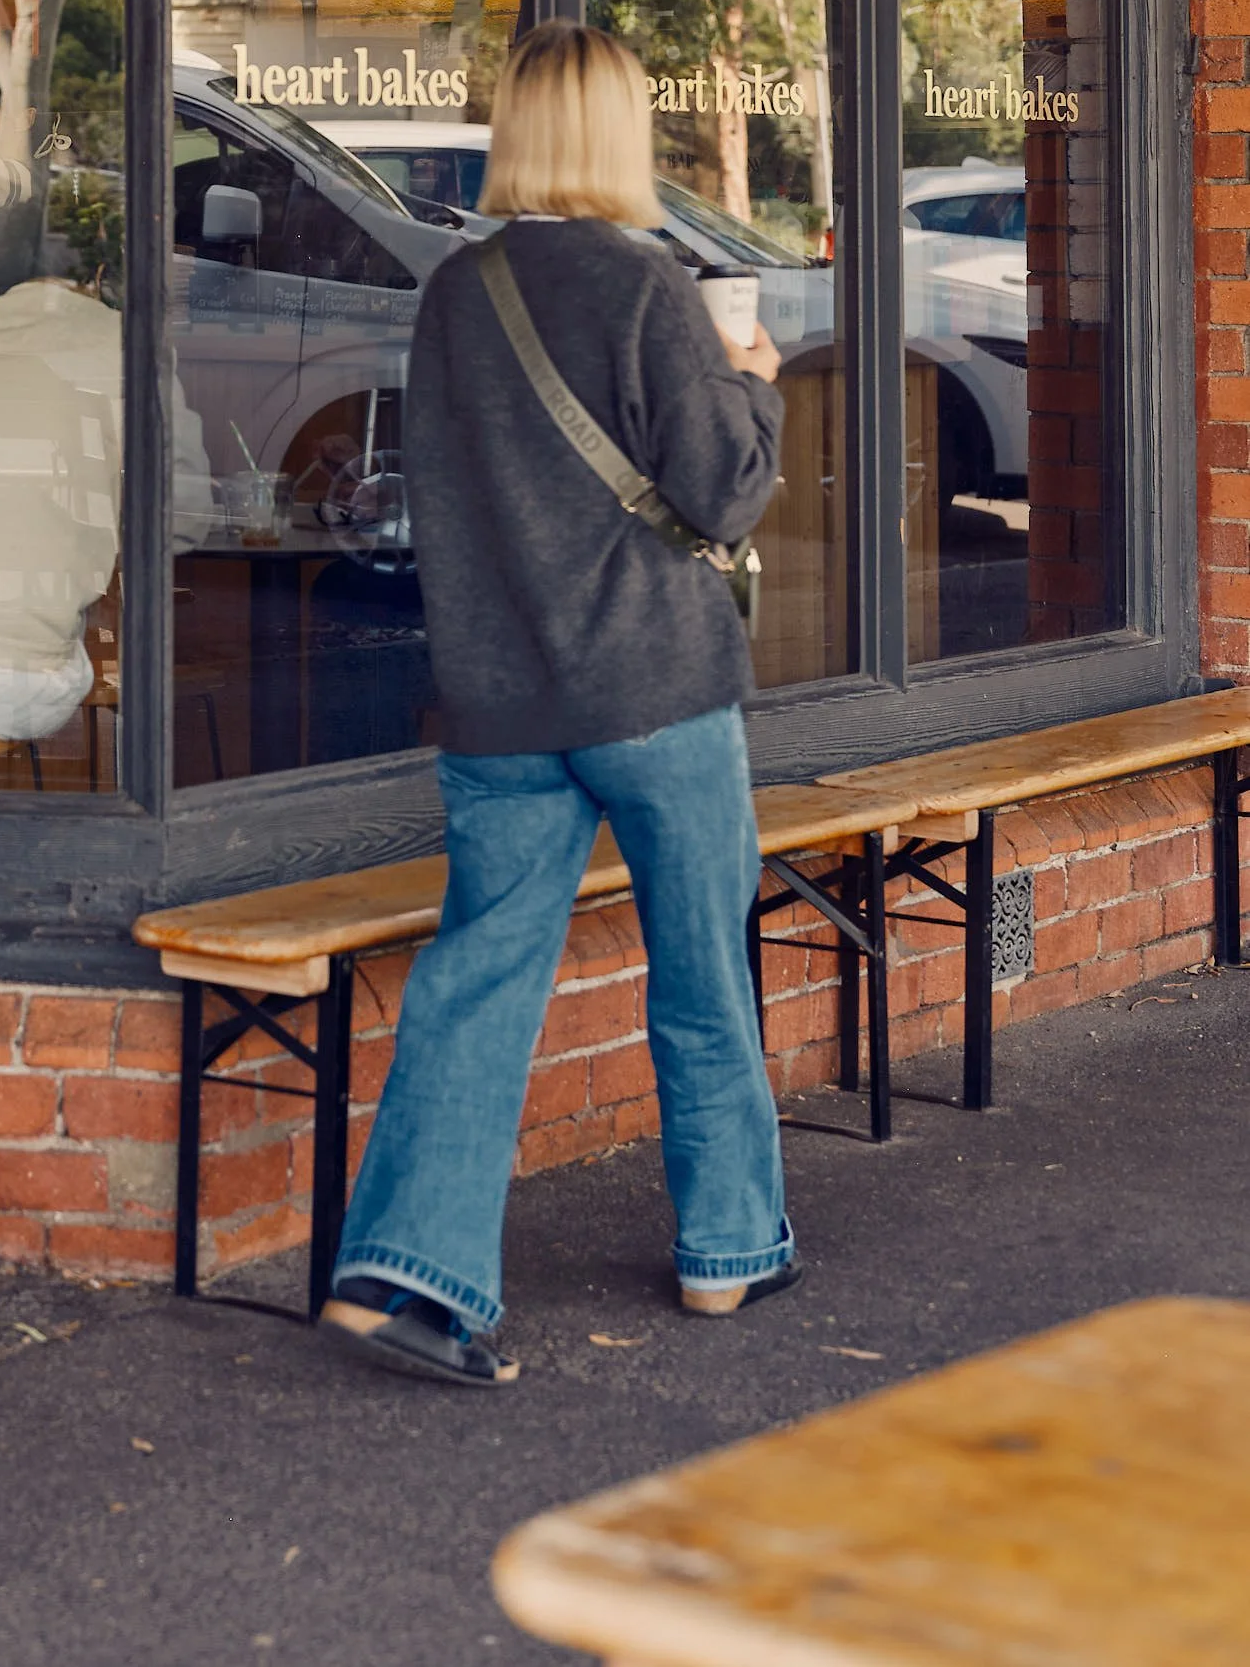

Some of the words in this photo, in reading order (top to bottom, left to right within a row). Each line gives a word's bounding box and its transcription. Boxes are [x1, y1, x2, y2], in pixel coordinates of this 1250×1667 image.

[232, 43, 349, 106] heart
[354, 47, 469, 108] bakes
[645, 68, 708, 113] eart
[713, 61, 805, 117] bakes
[924, 69, 1000, 120] heart
[1004, 73, 1079, 123] bakes
[548, 387, 603, 454] ROAD
